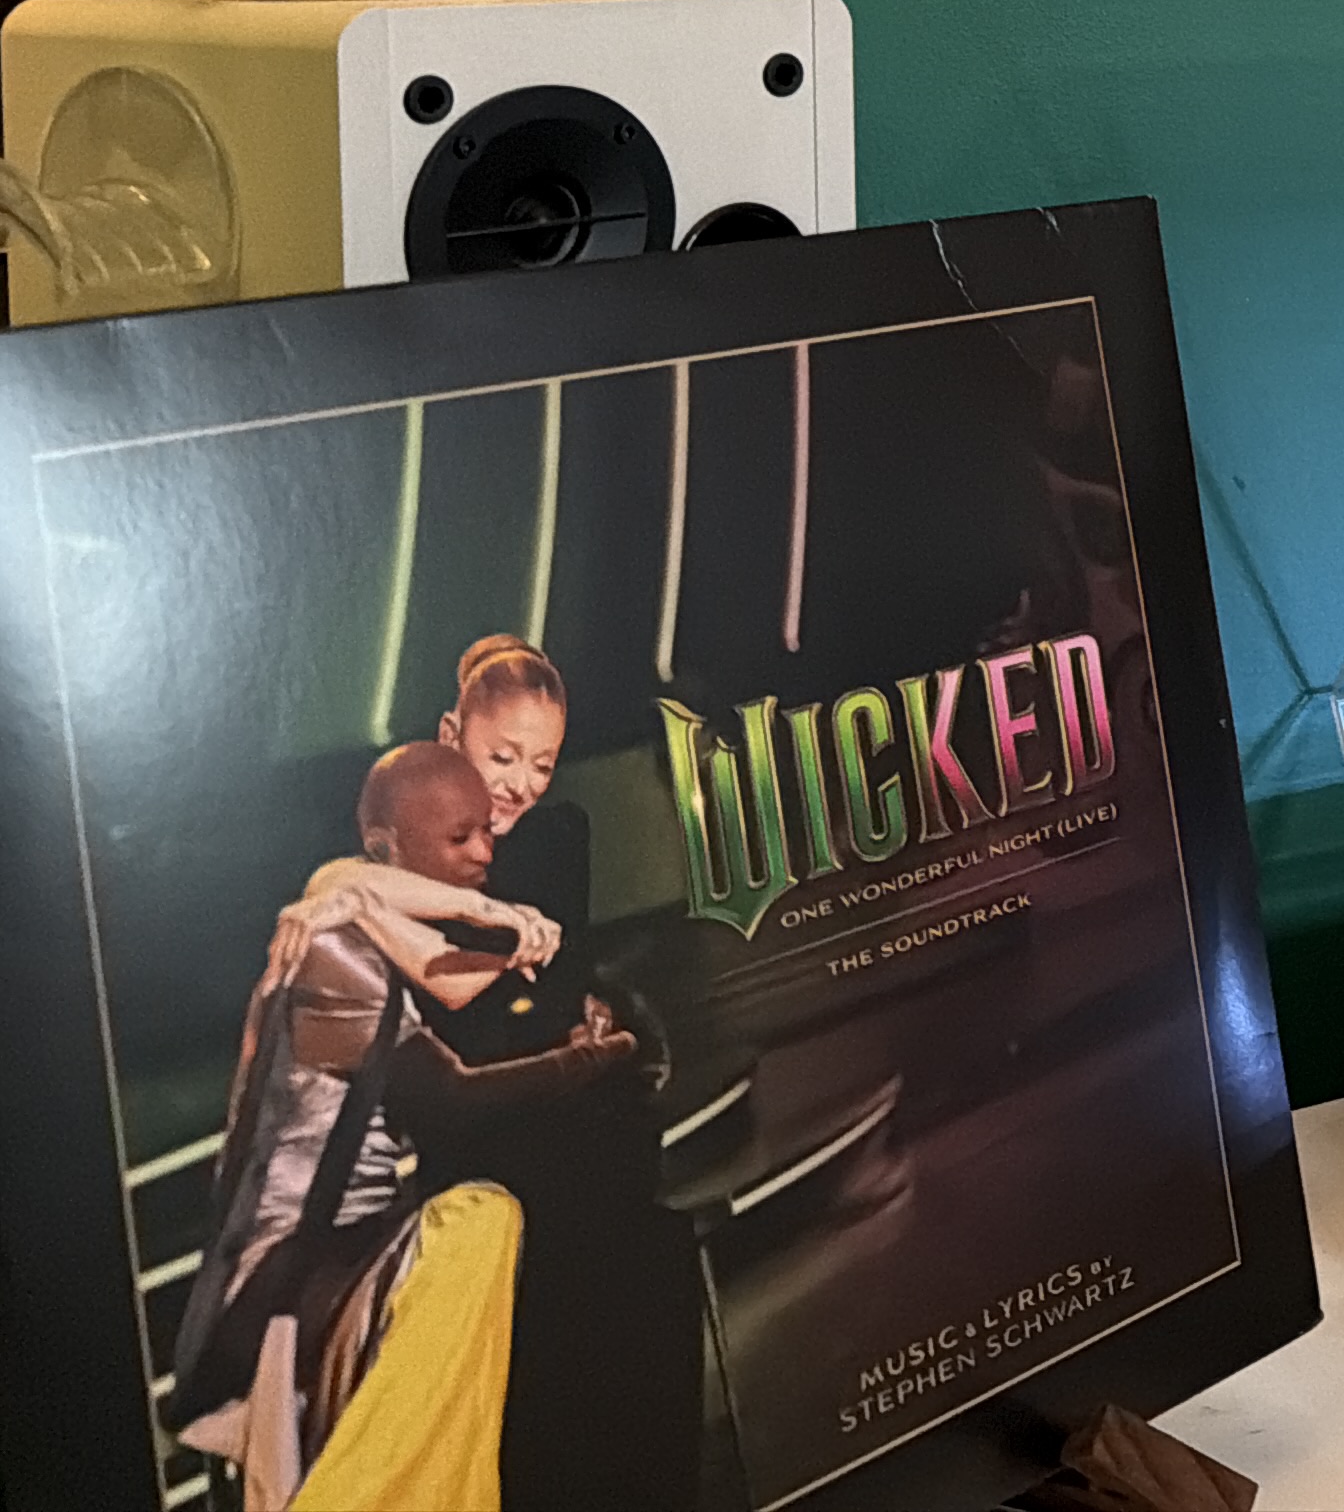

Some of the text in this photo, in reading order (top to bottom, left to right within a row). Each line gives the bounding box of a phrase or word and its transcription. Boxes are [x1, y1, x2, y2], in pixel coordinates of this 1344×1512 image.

[656, 633, 1117, 942] WICKED
[780, 800, 1120, 930] ONE WONDERFUL NIGHT (LIVE)
[825, 890, 1033, 977] THE SOUNDTRACK
[839, 1266, 1136, 1433] STEPHEN SCHWARTZ
[859, 1325, 959, 1393] MUSIC
[982, 1263, 1083, 1329] LYRICS
[1089, 1254, 1113, 1276] BY
